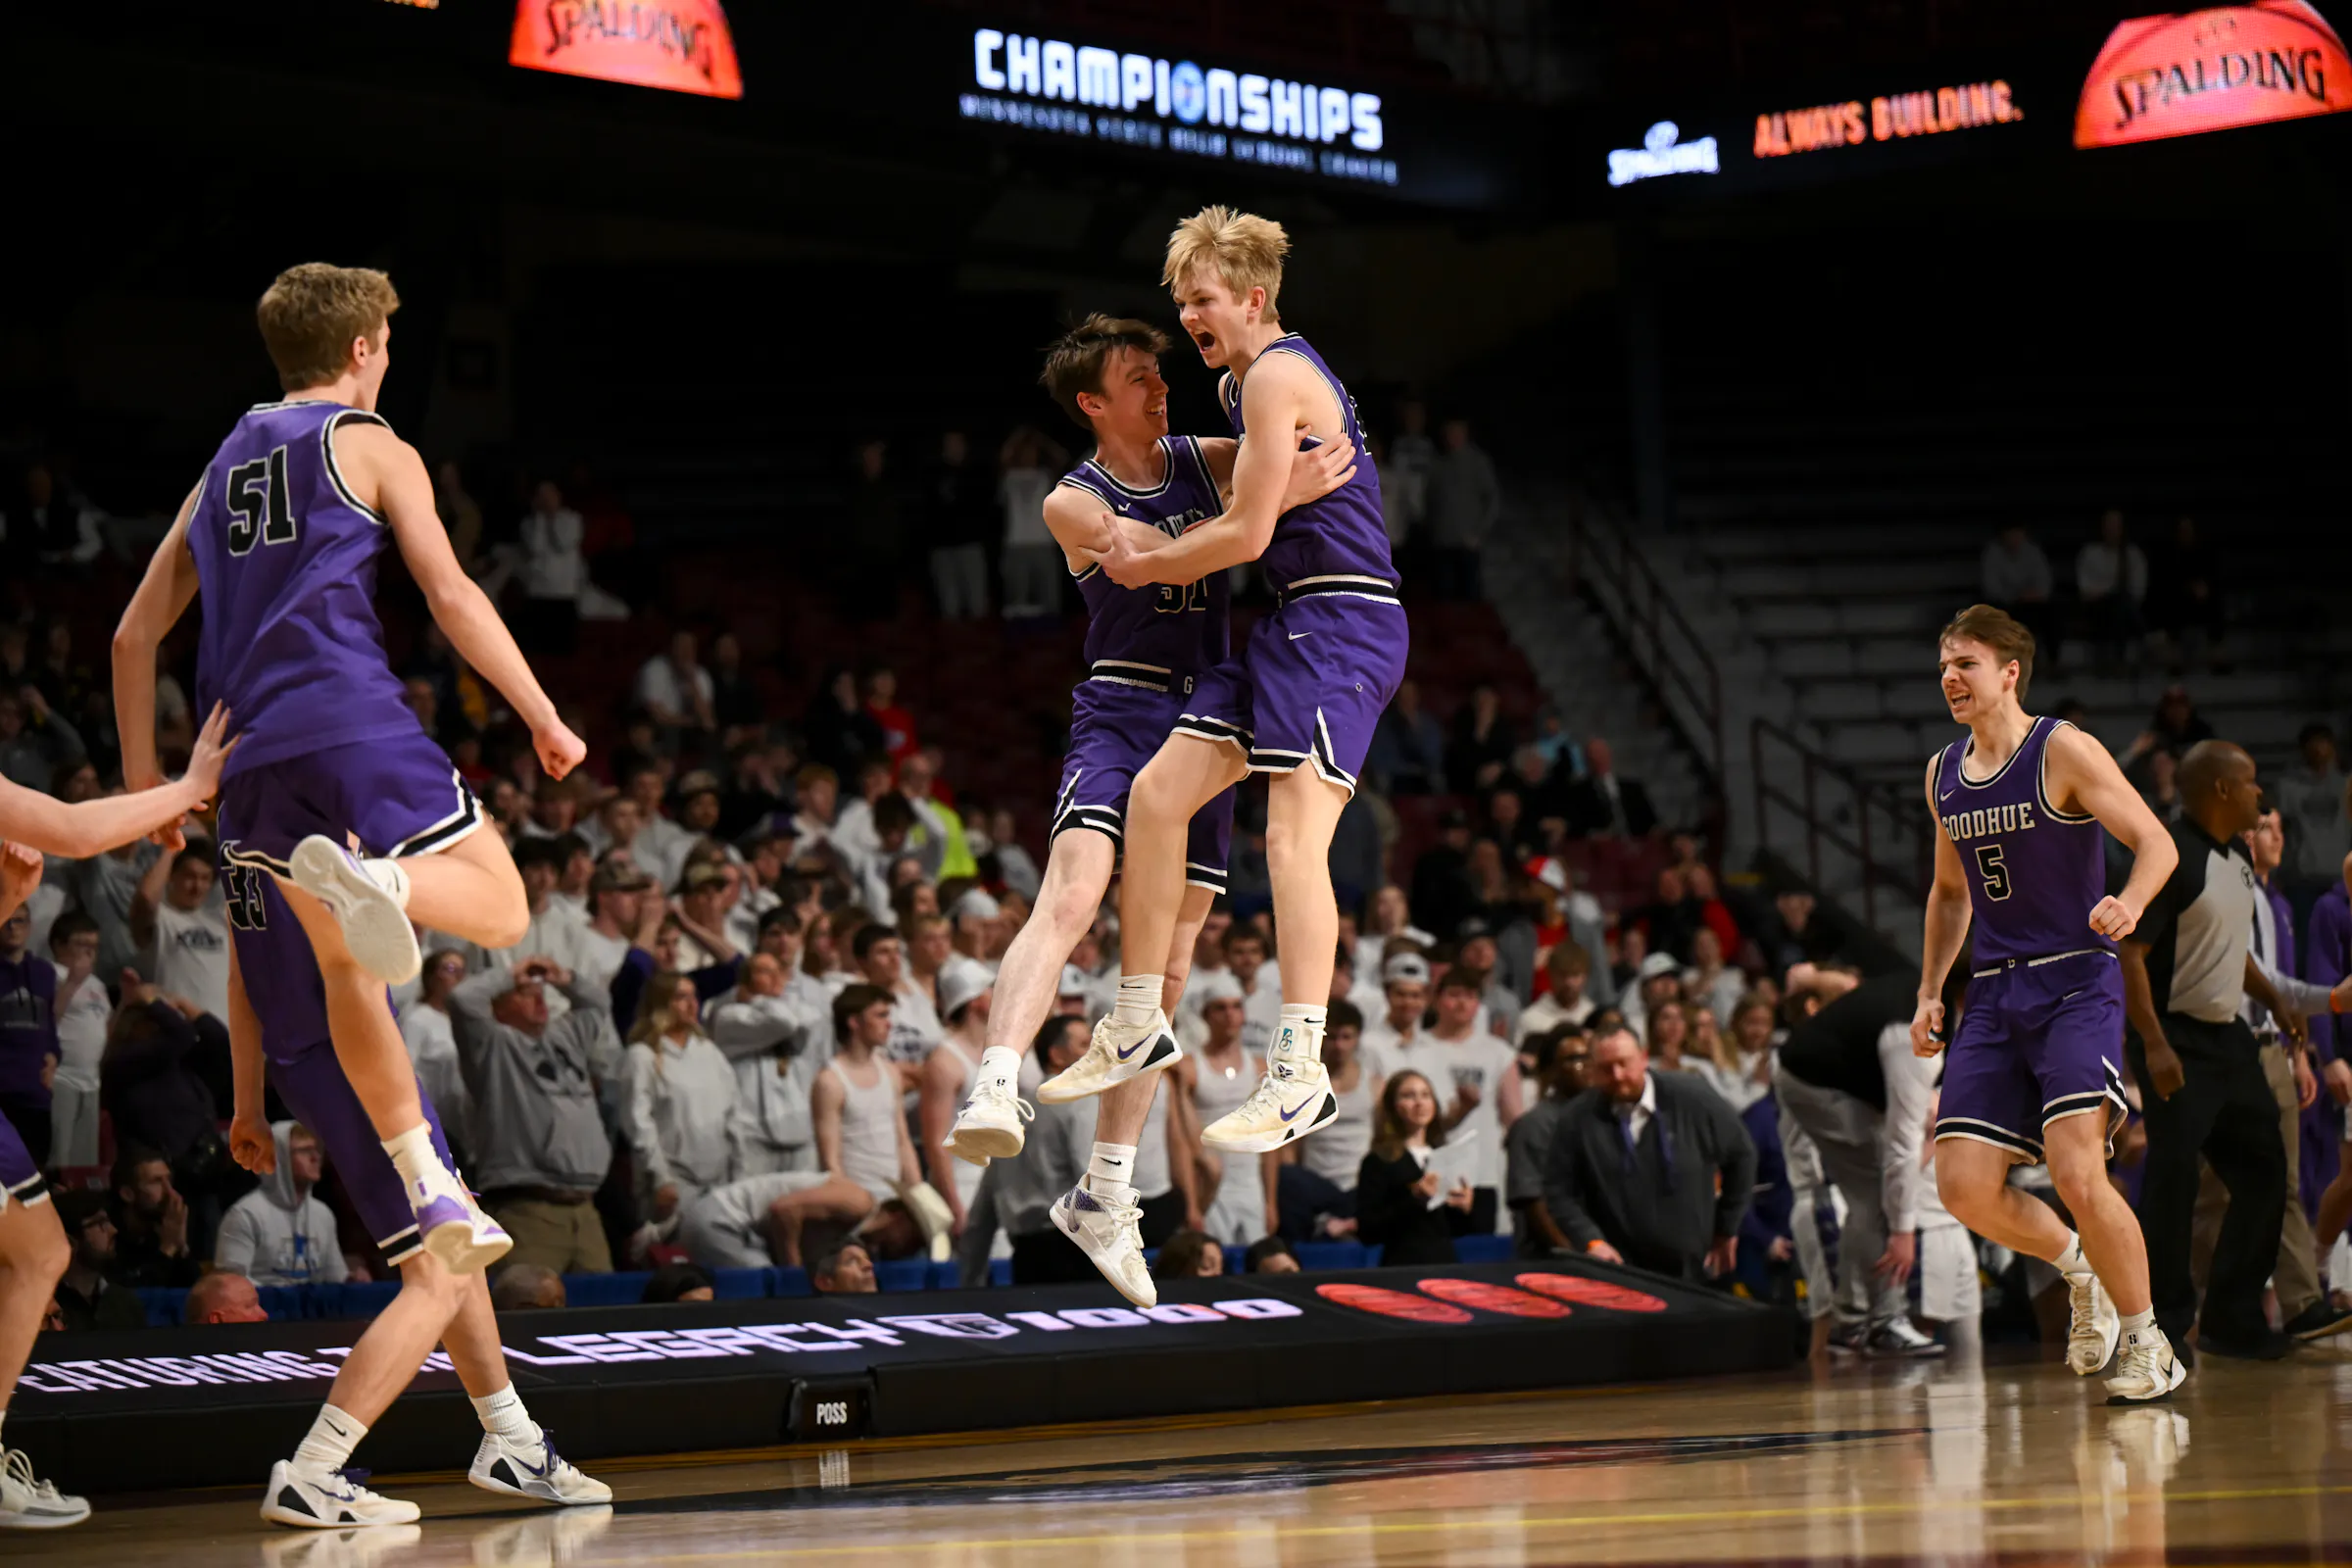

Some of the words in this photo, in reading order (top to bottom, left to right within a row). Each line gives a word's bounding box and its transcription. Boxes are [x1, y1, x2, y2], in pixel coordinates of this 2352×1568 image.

[974, 28, 1384, 152] CHAMPIONSHIPS
[2114, 47, 2327, 131] SPALDING
[1753, 100, 1867, 159] ALWAYS
[225, 444, 296, 557] 51
[1975, 844, 2012, 902] 5
[1006, 1298, 1303, 1331] 1000
[816, 1401, 847, 1425] POSS
